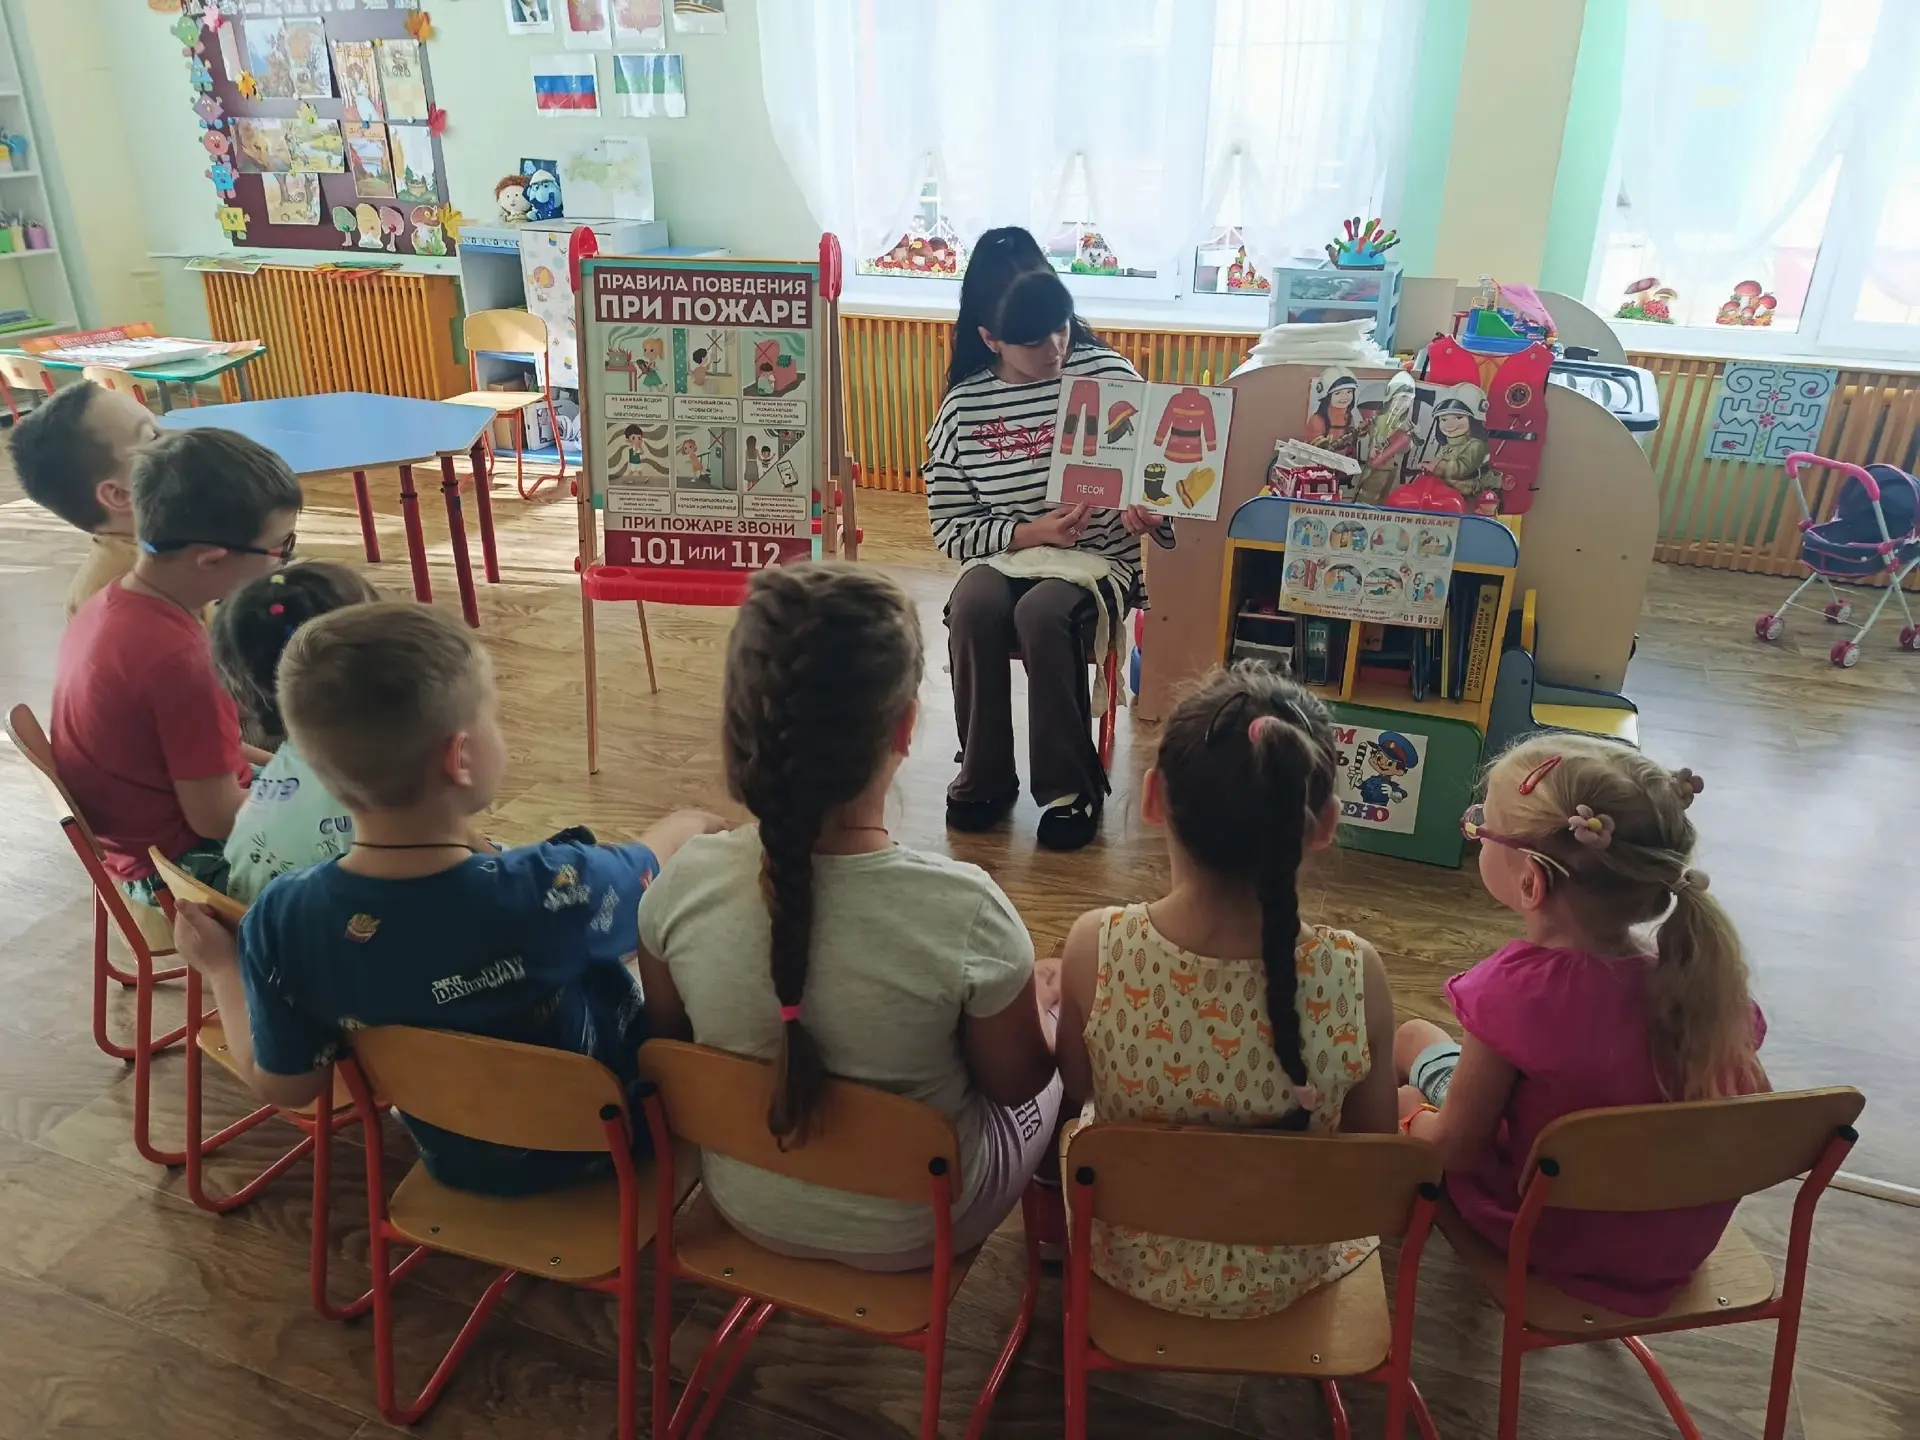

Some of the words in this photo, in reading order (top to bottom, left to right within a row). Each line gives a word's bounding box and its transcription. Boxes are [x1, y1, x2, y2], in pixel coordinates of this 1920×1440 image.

[599, 273, 688, 291] ПРАВИЛА
[692, 276, 806, 295] ПОВЕДЕНИЯ
[600, 294, 663, 320] ПРИ
[672, 297, 807, 325] ПОЖАРЕ
[1076, 484, 1105, 495] ПЕСОК
[622, 515, 656, 530] ПРИ
[661, 517, 734, 533] ПОЖАРЕ
[737, 520, 795, 536] ЗВОНИ
[1295, 507, 1336, 517] ПРАВИЛА
[1339, 511, 1392, 522] ПОВЕДЕНИЯ
[1394, 516, 1412, 524] ПРИ
[1415, 518, 1454, 528] ПОЖАРЕ
[630, 536, 685, 565] 101
[732, 541, 781, 569] 112
